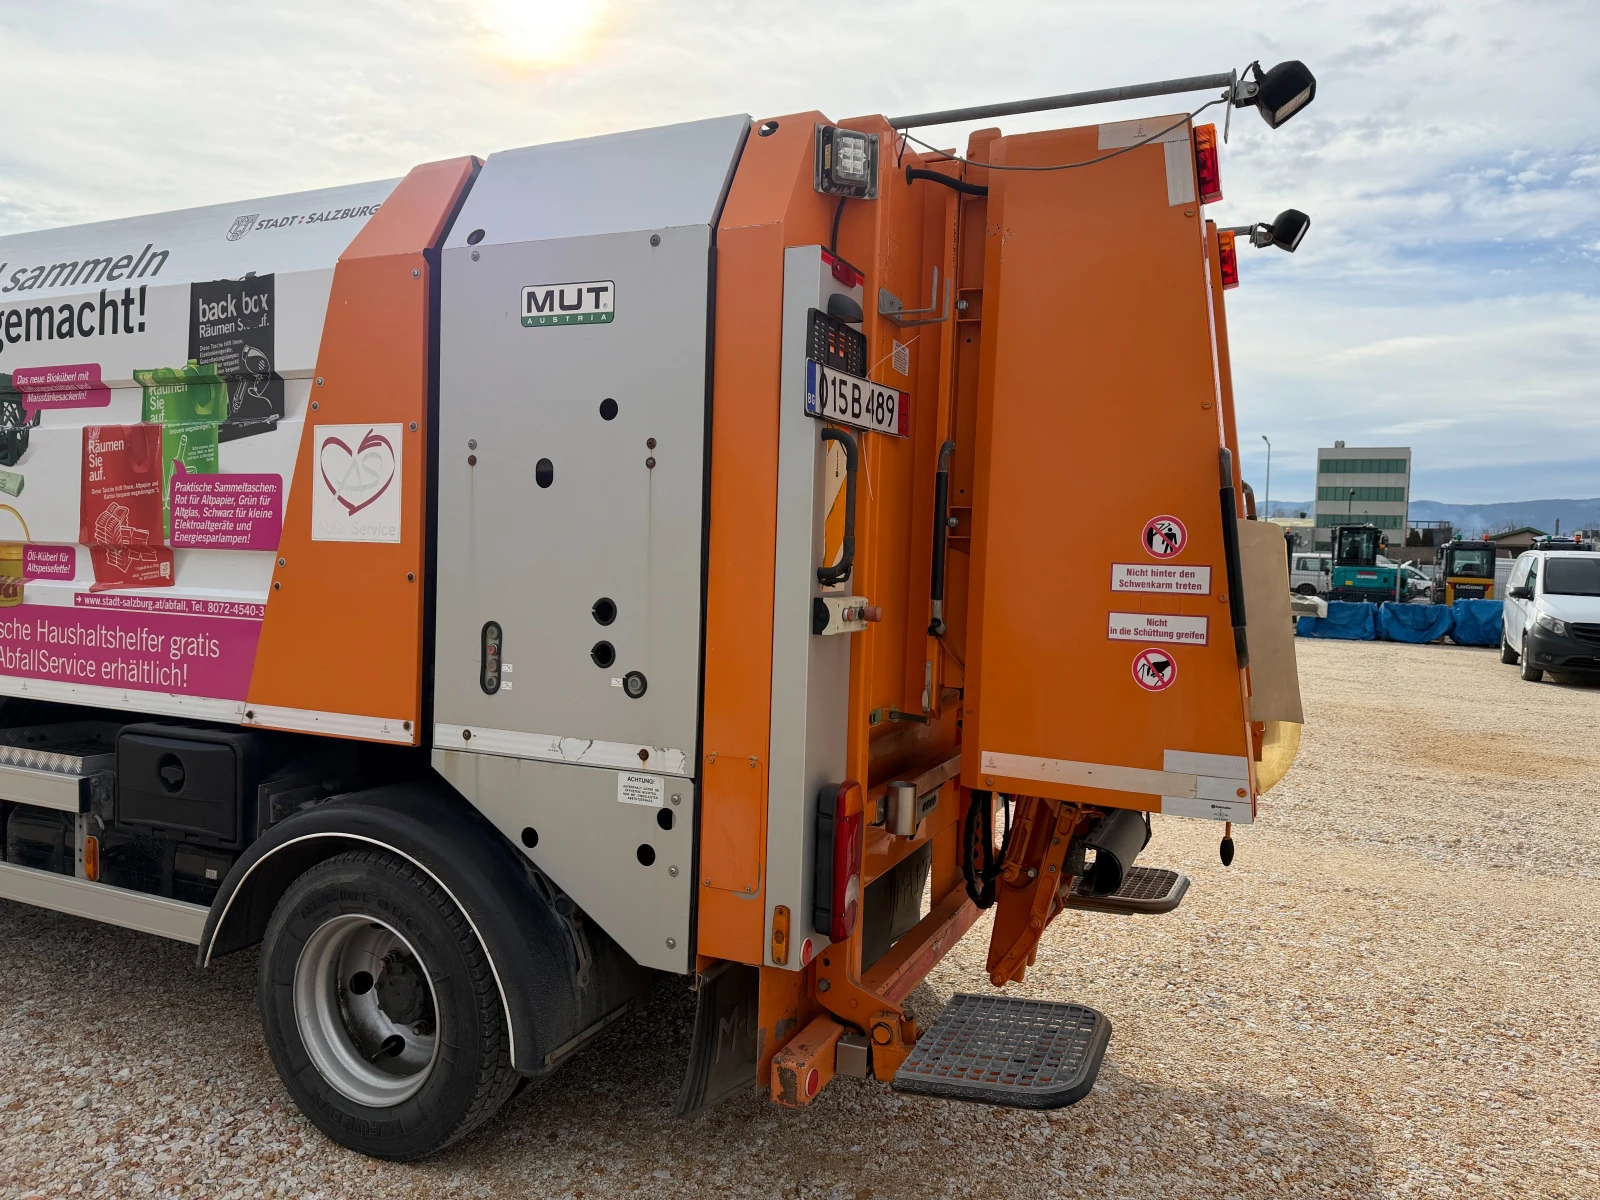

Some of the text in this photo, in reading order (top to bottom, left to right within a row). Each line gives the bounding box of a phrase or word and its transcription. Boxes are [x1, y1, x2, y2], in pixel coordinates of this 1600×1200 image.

[255, 215, 298, 231] STADT
[305, 203, 381, 224] SALZBURG
[1, 243, 170, 293] sammeln
[526, 286, 609, 314] MUT
[198, 293, 238, 323] back
[527, 313, 607, 325] AUSTRIA
[199, 322, 235, 339] Räumen
[16, 371, 89, 385] Das neue Bioküberl mit
[149, 396, 165, 410] Sie
[807, 392, 816, 405] BG
[150, 410, 168, 422] auf.
[88, 439, 125, 454] Räumen
[88, 454, 103, 468] Sie
[88, 467, 106, 482] auf.
[174, 482, 277, 493] Praktische Sammeltaschen:
[174, 494, 271, 506] Rot für Altpapier, Grün für
[174, 506, 273, 519] Altglas, Schwarz für kleine
[174, 519, 253, 532] Elektroaltgeräte und
[174, 531, 251, 546] Energiesparlampen!
[27, 550, 69, 562] Öli-Küberl für
[26, 562, 71, 574] Altspeisefette!
[1126, 568, 1196, 579] Nicht hinter den
[1118, 579, 1202, 591] Schwenkarm treten
[84, 596, 265, 617] www.stadt-salzburg.at/abfall, Tel. 8072-4540-3
[1146, 618, 1168, 627] Nicht
[36, 619, 165, 653] Haushaltshelfer
[169, 632, 220, 660] gratis
[1110, 627, 1205, 640] in die Schüttung greifen
[101, 657, 188, 687] erhältlich!
